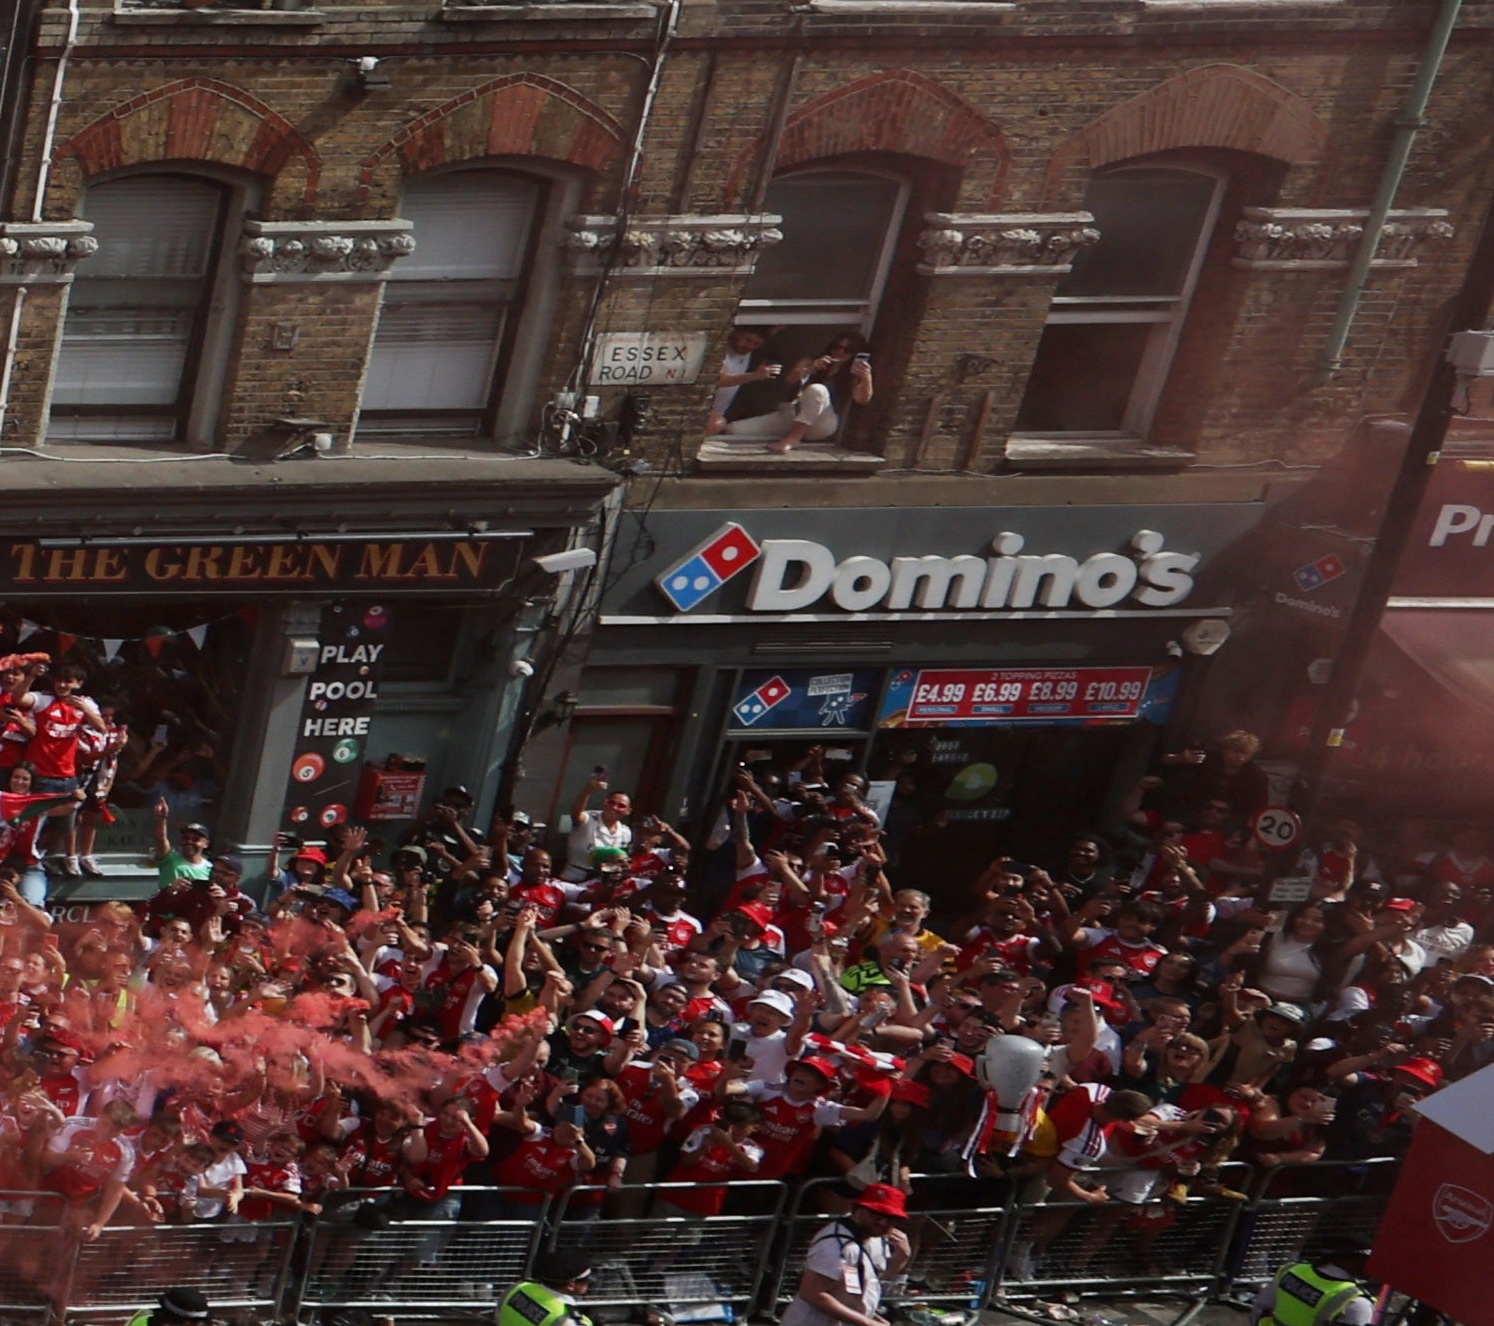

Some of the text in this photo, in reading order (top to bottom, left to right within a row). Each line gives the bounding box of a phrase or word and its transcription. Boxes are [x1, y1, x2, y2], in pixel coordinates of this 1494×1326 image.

[611, 346, 687, 361] ESSEX
[599, 365, 653, 380] ROAD
[10, 542, 489, 581] THE GREEN MAN
[747, 530, 1199, 611] Domino's
[1275, 592, 1341, 618] Domino's
[321, 644, 385, 664] PLAY
[309, 681, 378, 701] POOL
[916, 681, 1142, 703] £4.99 £6.99 £8.99 £10.99
[303, 717, 371, 737] HERE
[1259, 815, 1294, 841] 20
